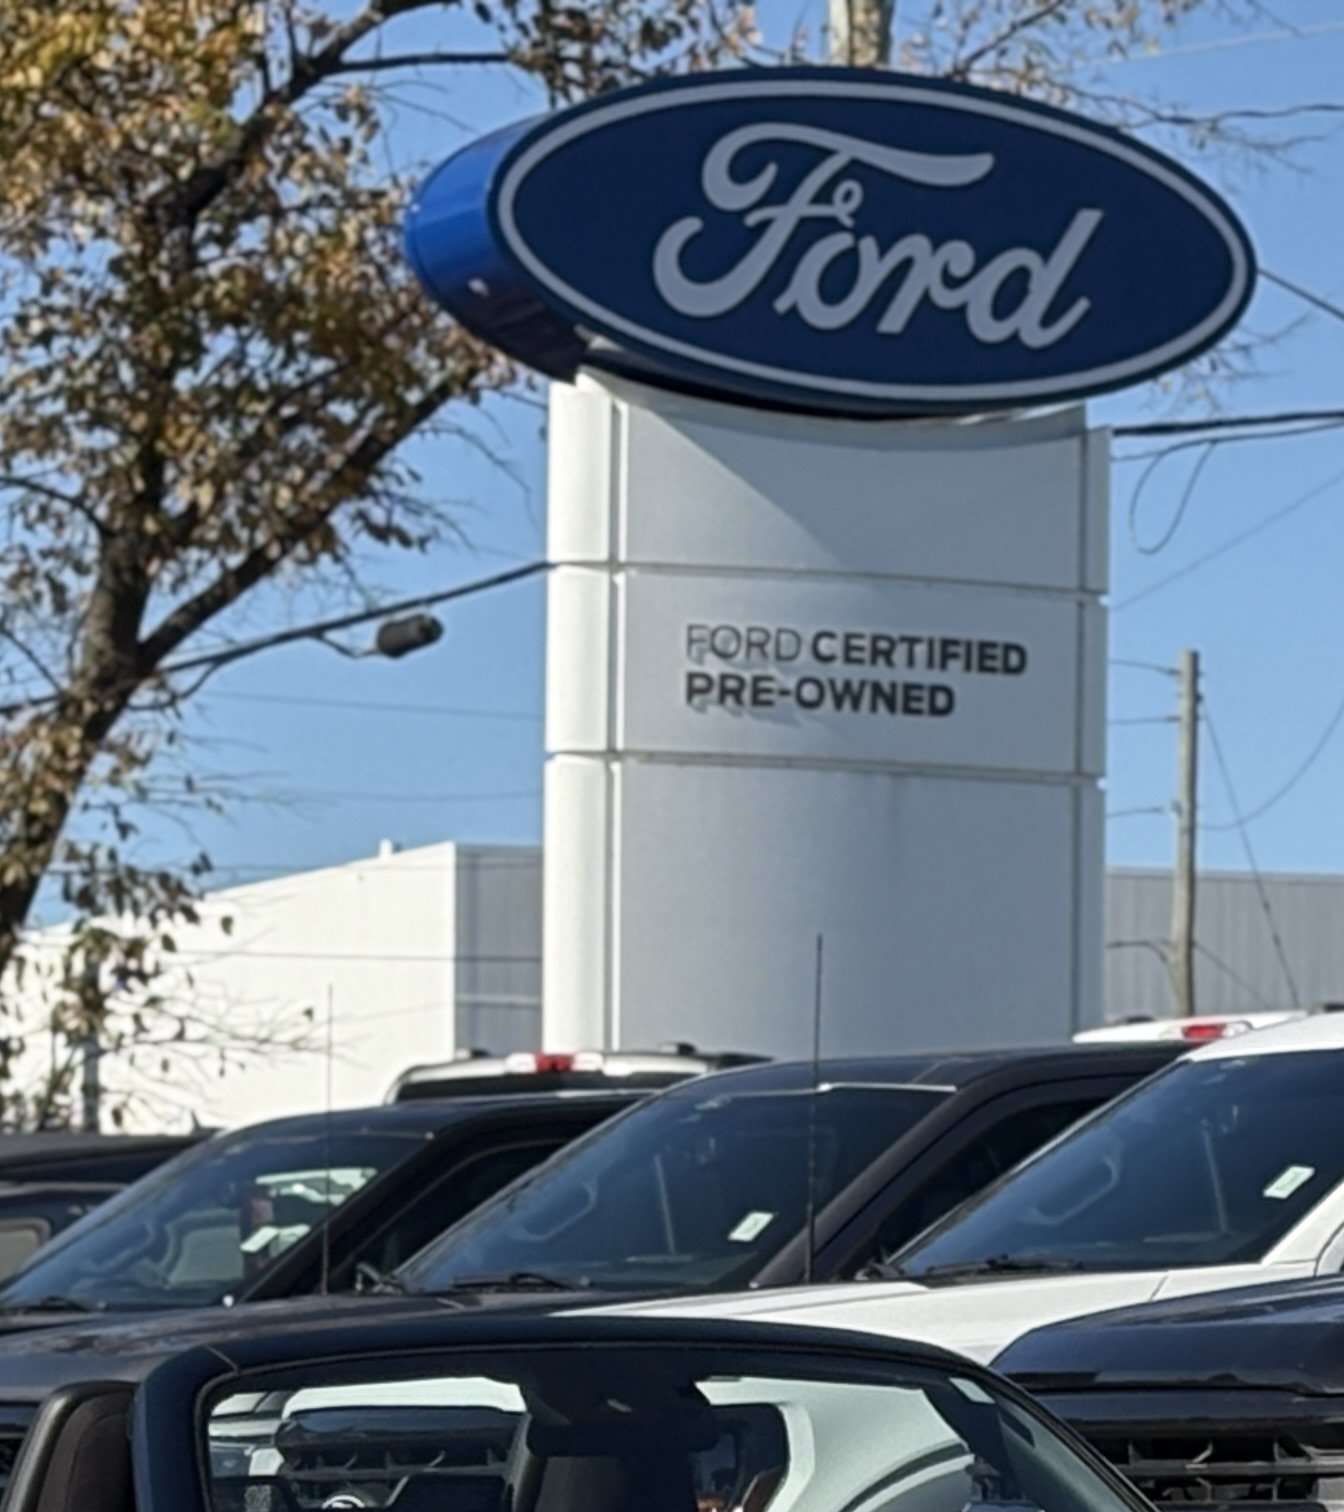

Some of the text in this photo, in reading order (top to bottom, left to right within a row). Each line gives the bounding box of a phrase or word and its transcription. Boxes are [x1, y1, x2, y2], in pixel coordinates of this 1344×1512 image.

[652, 122, 1104, 349] Ford
[686, 623, 1029, 676] FORD CERTIFIED
[685, 671, 956, 717] PRE-OWNED
